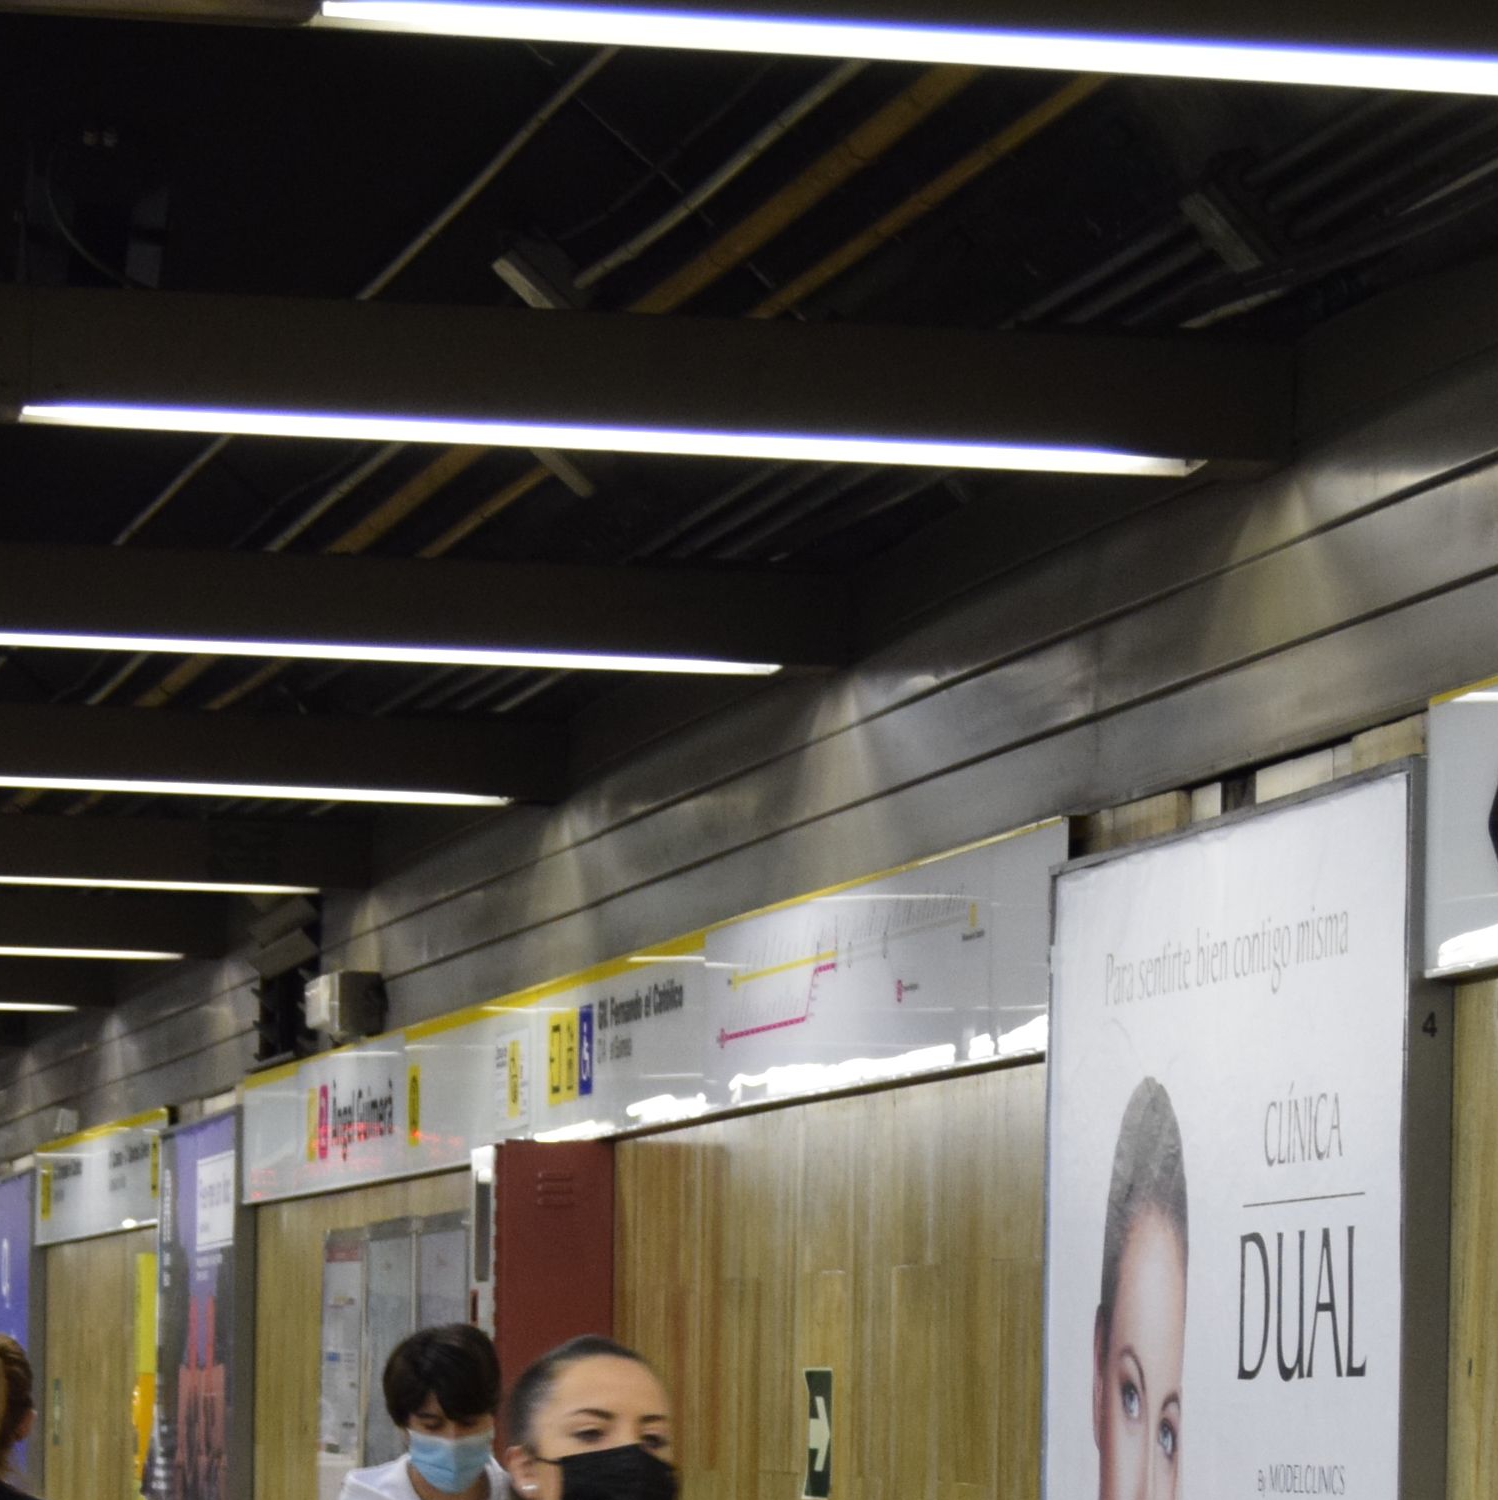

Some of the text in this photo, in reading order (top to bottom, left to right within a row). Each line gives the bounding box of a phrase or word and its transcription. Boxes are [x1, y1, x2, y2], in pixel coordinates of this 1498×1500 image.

[1105, 905, 1349, 1006] Para sentirte bien contigo misma
[1422, 1011, 1437, 1038] 4
[1264, 1080, 1343, 1167] CLÍNICA
[1237, 1226, 1368, 1382] DUAL
